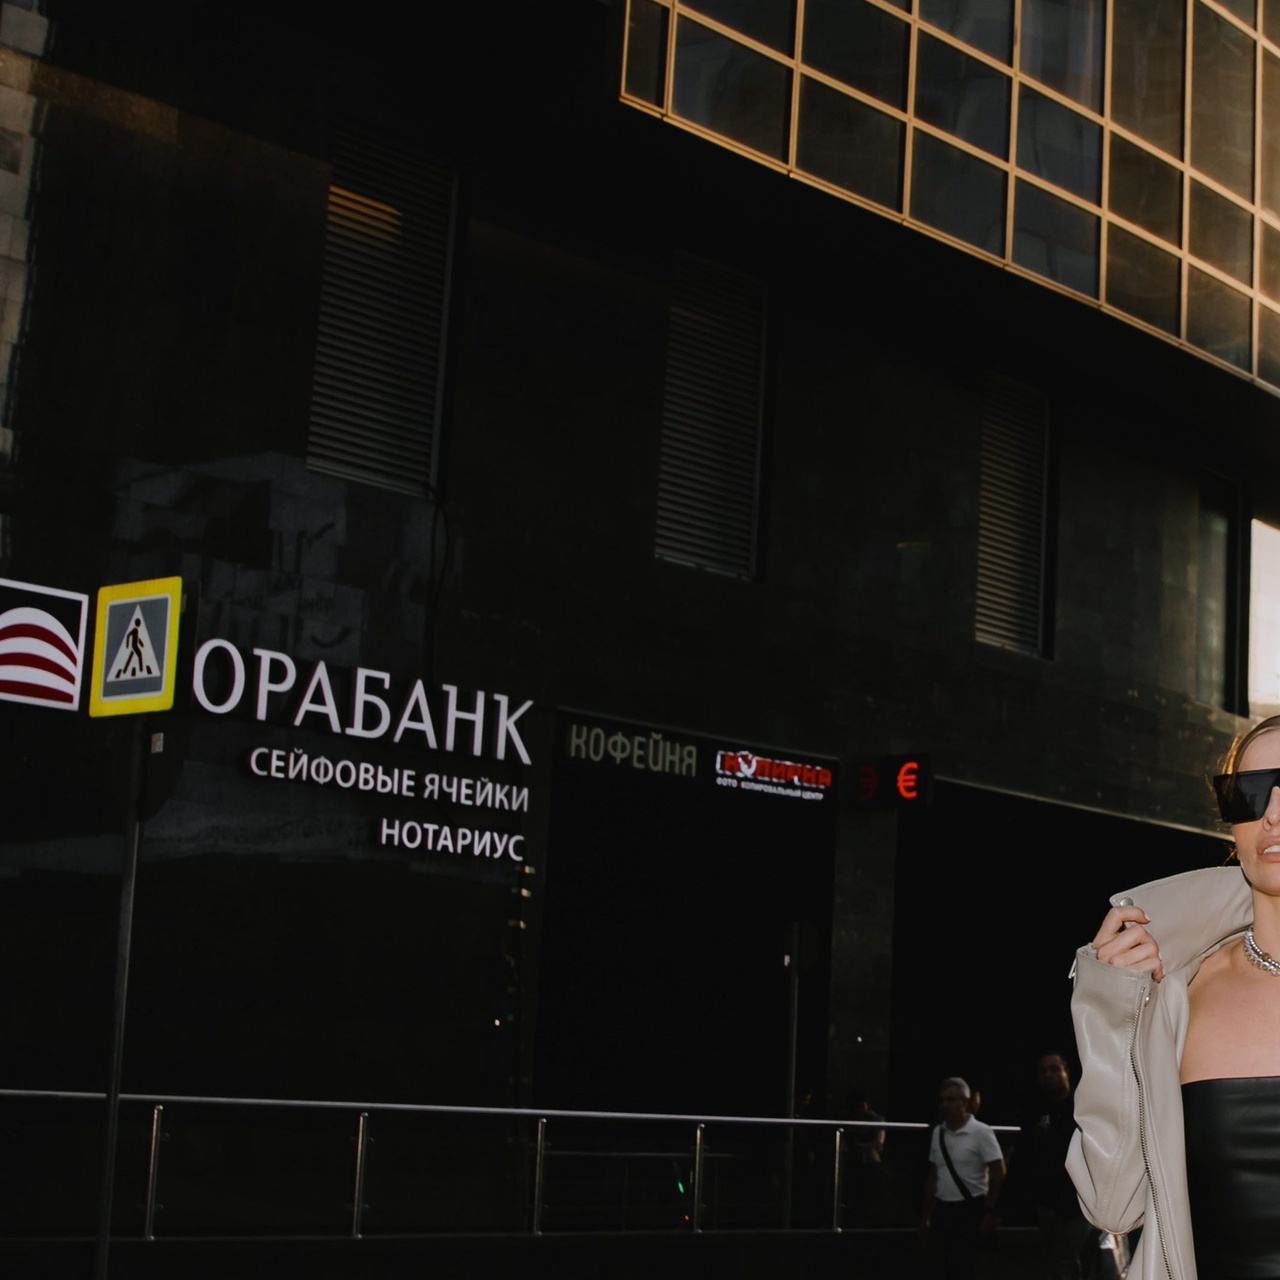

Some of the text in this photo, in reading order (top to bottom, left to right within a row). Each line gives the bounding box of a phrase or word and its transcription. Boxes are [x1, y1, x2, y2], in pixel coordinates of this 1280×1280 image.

[570, 724, 696, 777] КОФЕЙНЯ
[250, 747, 529, 812] СЕЙФОВЫЕ ЯЧЕЙКИ
[381, 818, 525, 861] НОТАРИУС
